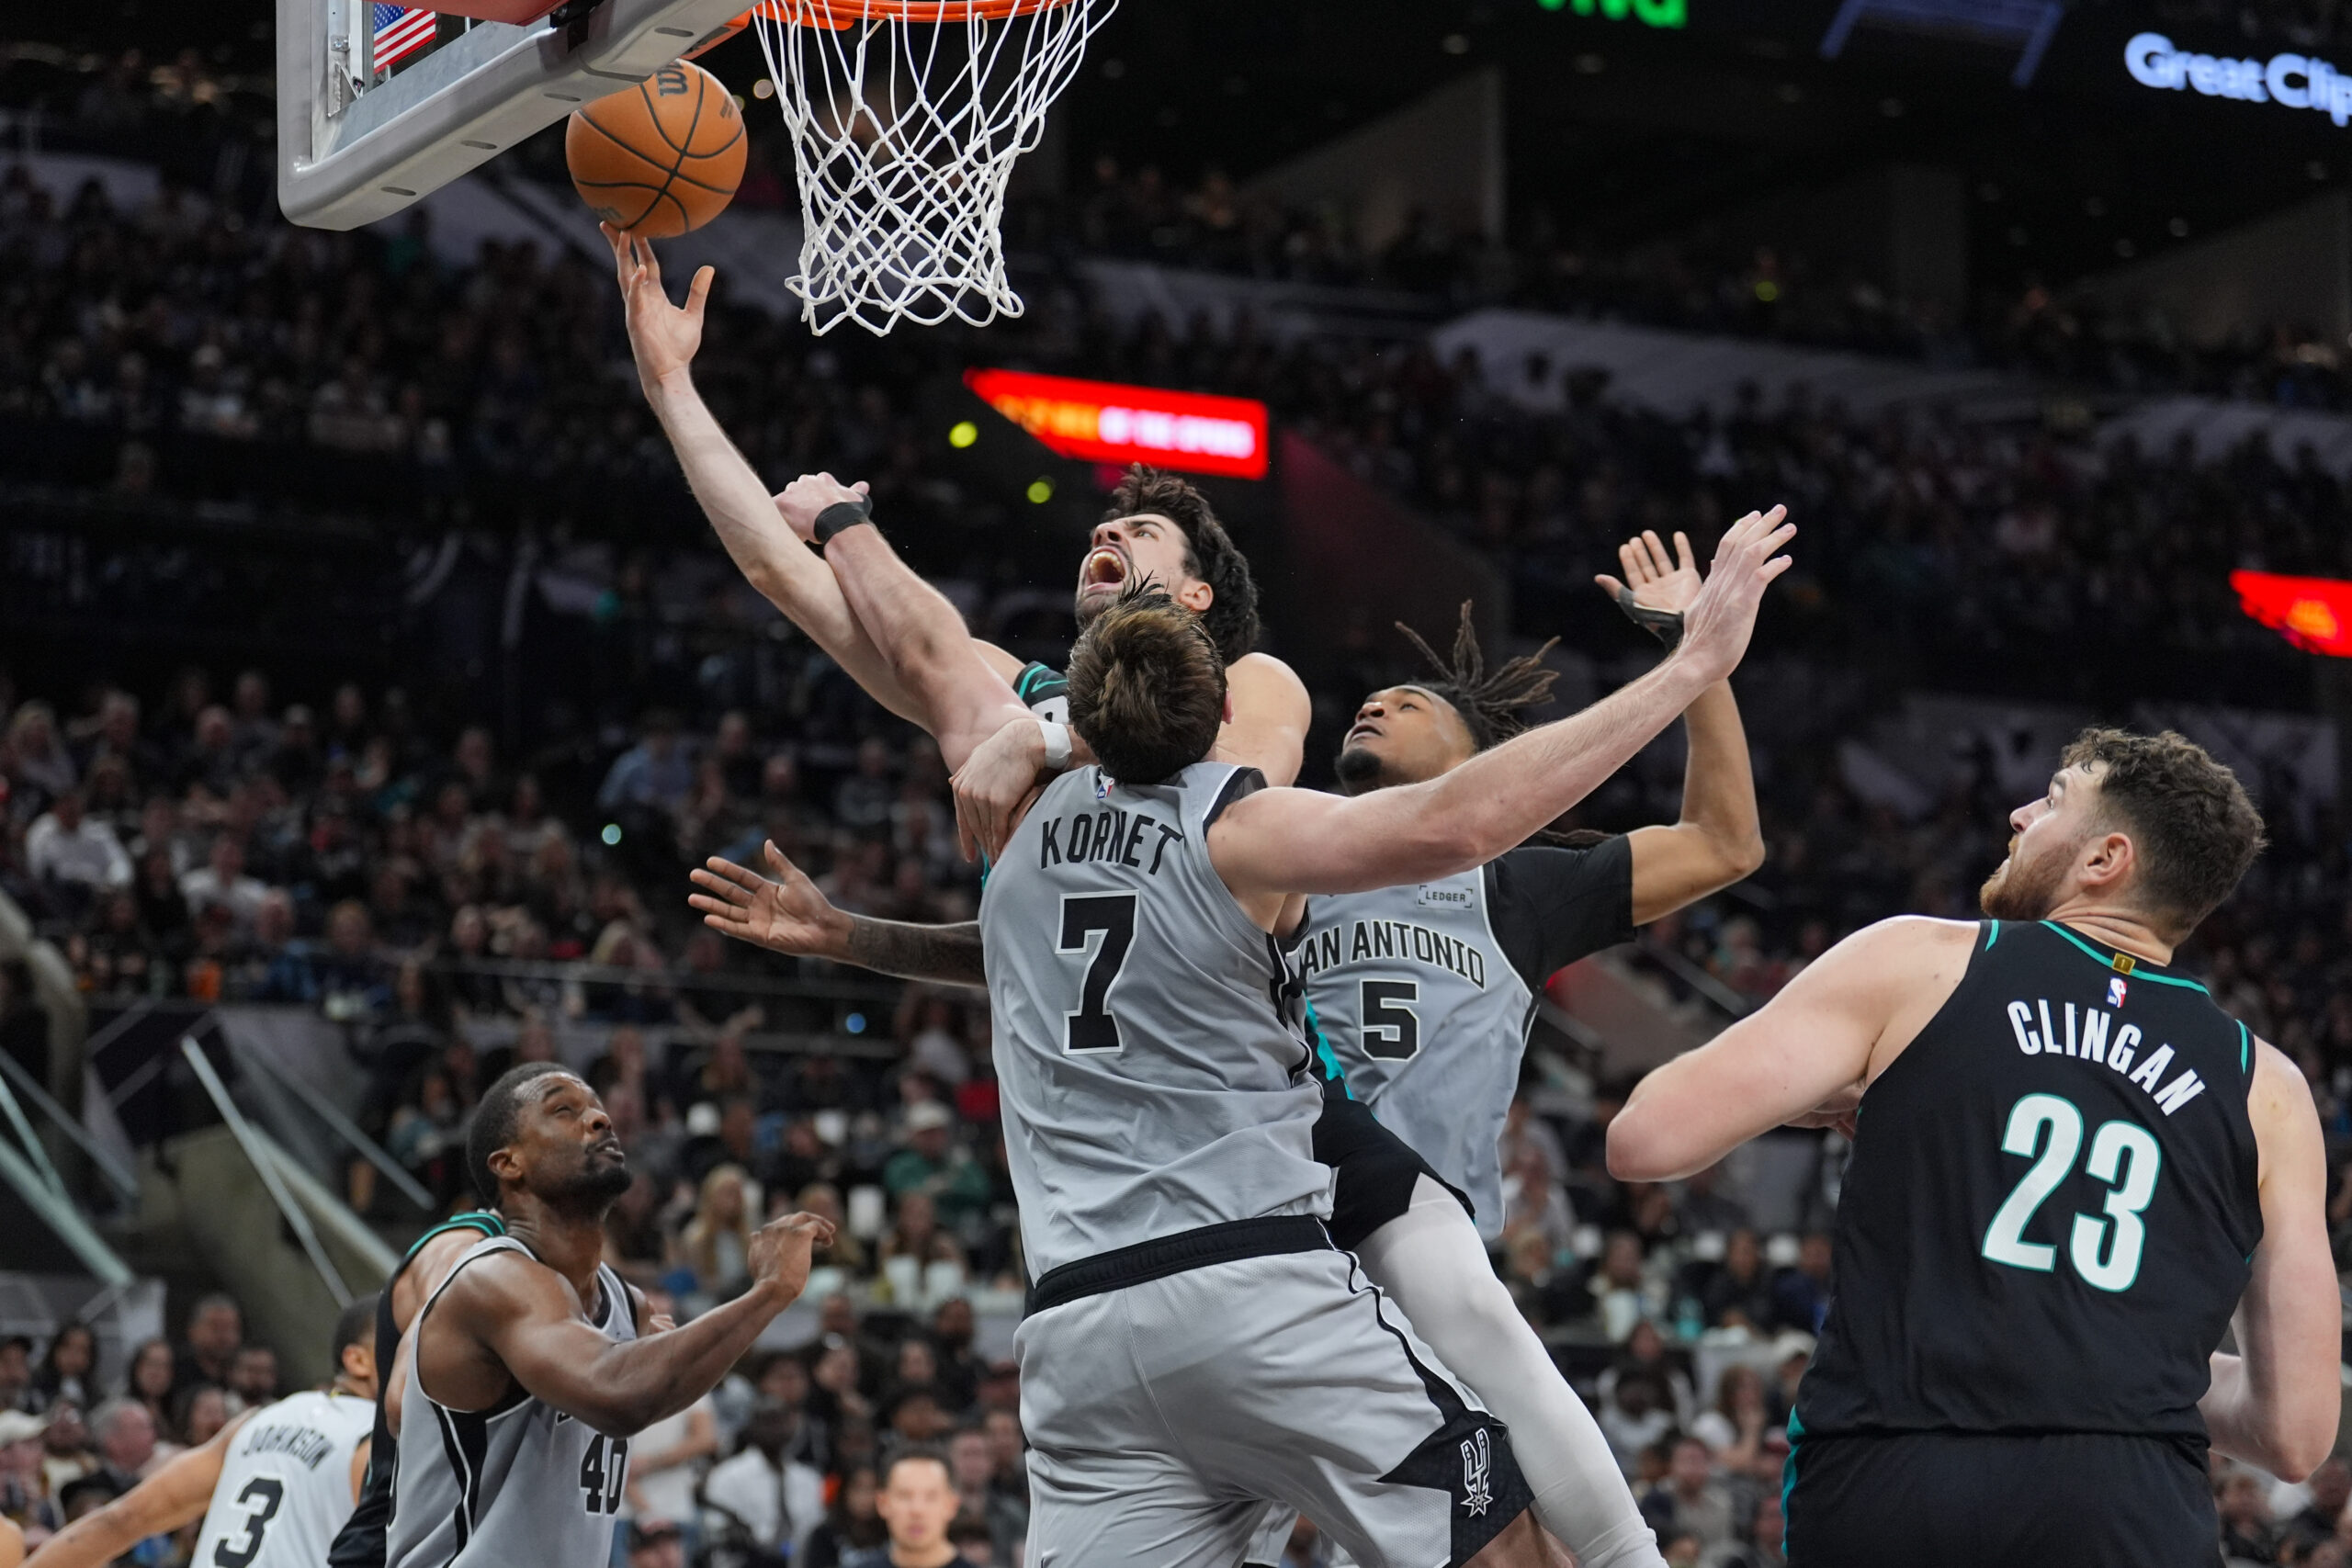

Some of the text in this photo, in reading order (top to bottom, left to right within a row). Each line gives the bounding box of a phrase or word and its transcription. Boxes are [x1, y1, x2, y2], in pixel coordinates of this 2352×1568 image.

[1041, 810, 1184, 875] KORNET
[1425, 891, 1466, 902] LEDGER
[1056, 889, 1139, 1055] 7
[1302, 919, 1486, 993] AN ANTONIO
[1360, 978, 1420, 1061] 5
[2007, 998, 2205, 1116] CLINGAN
[1981, 1092, 2162, 1293] 23
[242, 1424, 334, 1472] JOHNSON
[580, 1433, 629, 1516] 40
[212, 1473, 286, 1568] 3
